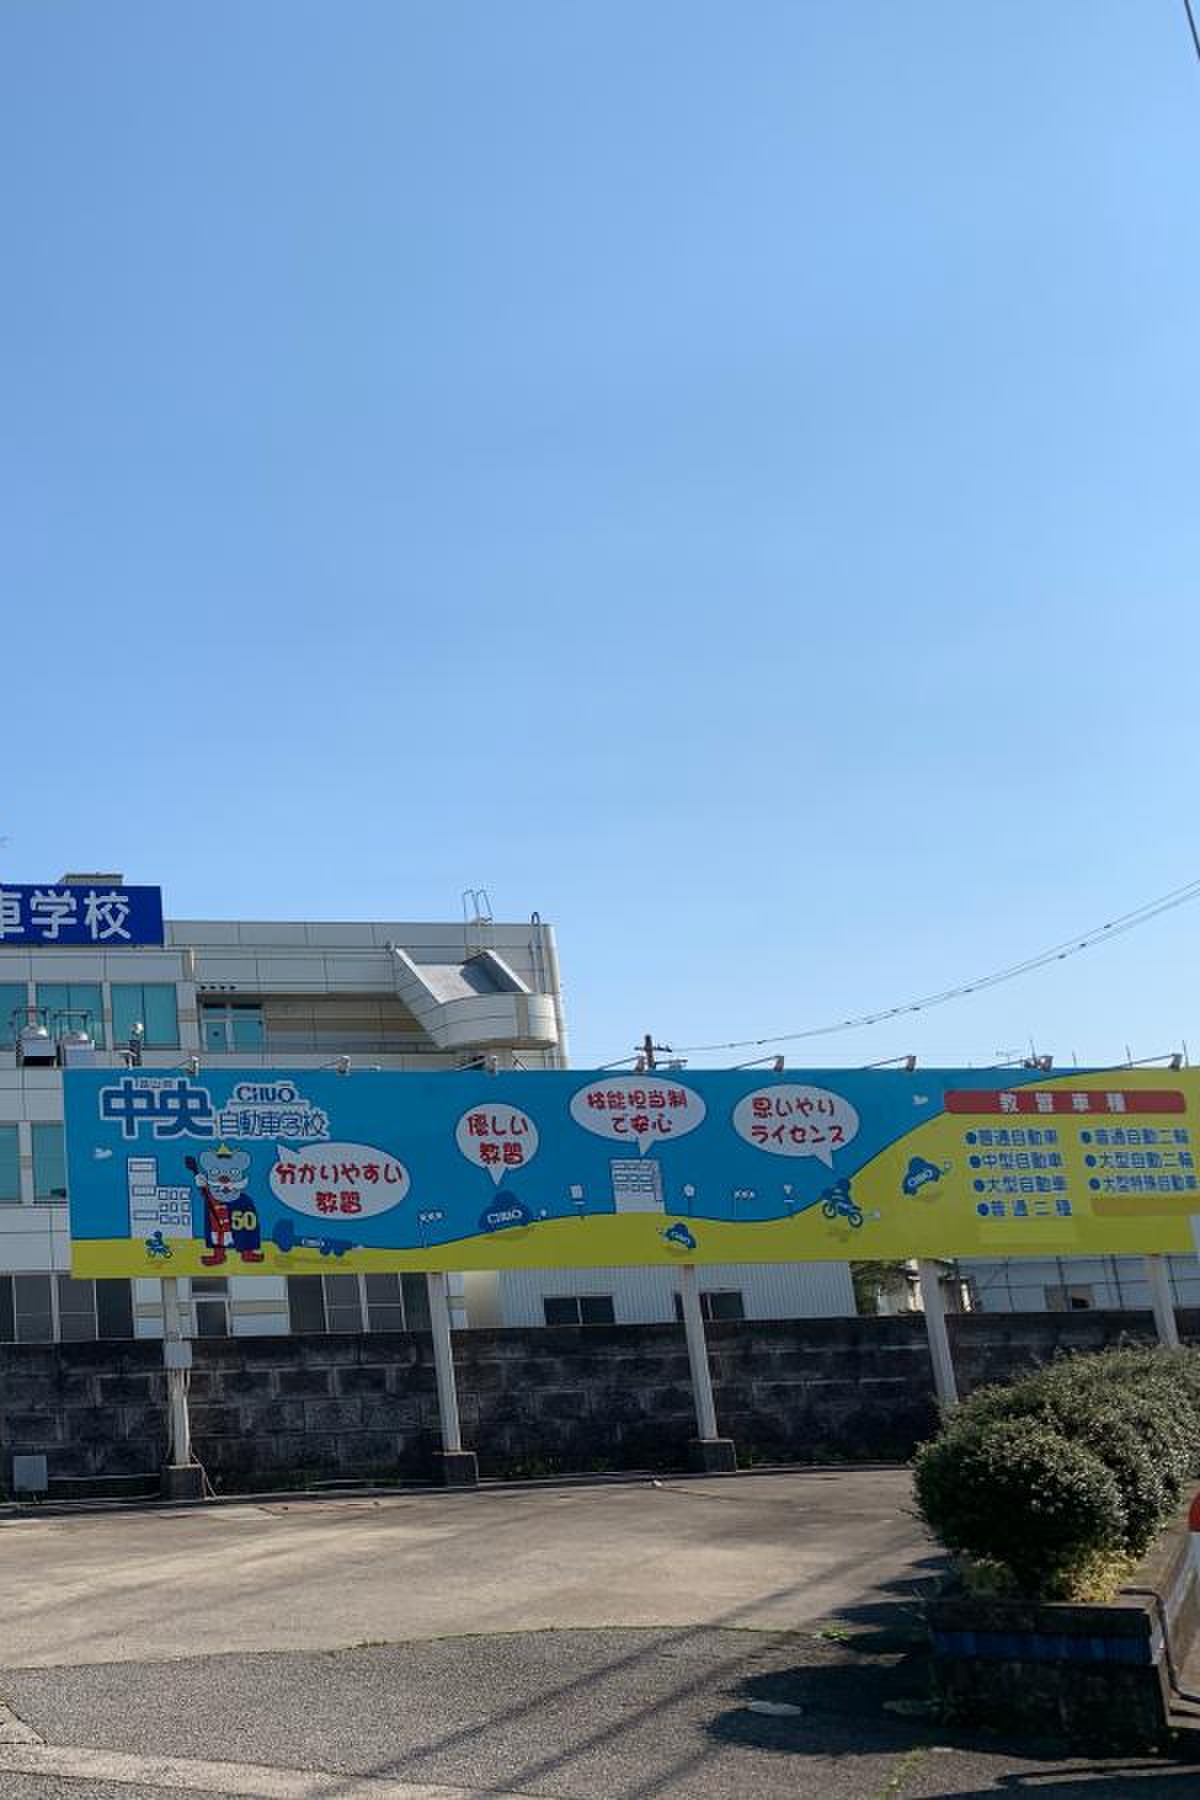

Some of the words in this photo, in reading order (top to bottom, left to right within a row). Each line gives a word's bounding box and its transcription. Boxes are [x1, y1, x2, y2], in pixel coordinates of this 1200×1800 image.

[102, 1080, 214, 1137] 中央
[752, 1096, 835, 1119] 思いやり
[219, 1110, 327, 1137] 自動車学校
[467, 1113, 529, 1137] 優しい
[611, 1112, 673, 1134] で安心
[751, 1124, 846, 1145] ライセンス
[479, 1141, 524, 1165] 教習
[275, 1162, 403, 1185] 分かりやすい
[315, 1191, 362, 1214] 教習
[231, 1211, 257, 1230] 50
